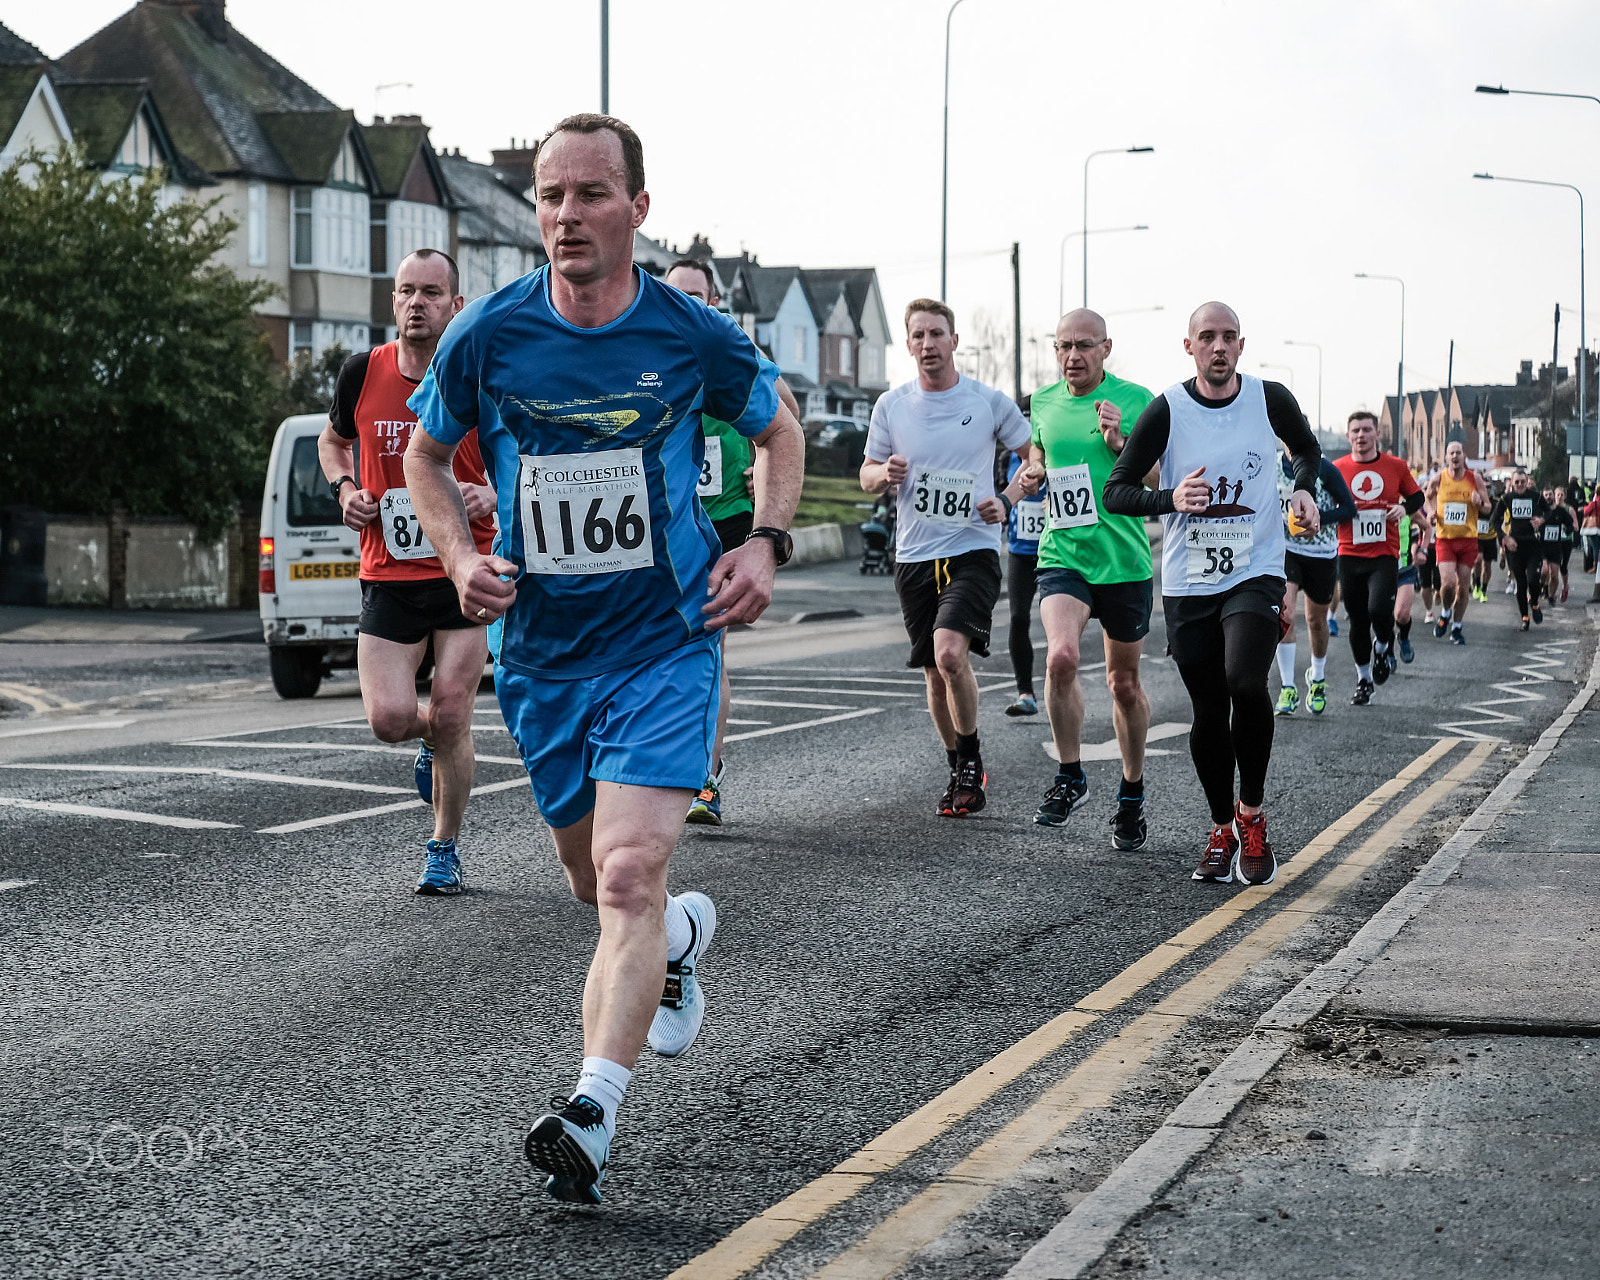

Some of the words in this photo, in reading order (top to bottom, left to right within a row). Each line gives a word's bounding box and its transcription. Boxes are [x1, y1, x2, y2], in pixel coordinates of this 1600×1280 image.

[544, 465, 640, 483] COLCHESTER
[547, 487, 575, 495] HALF
[578, 481, 640, 493] MARATHON
[915, 487, 971, 518] 3184
[393, 515, 423, 548] 87
[531, 494, 646, 556] 1166
[1360, 521, 1382, 537] 100
[1201, 531, 1250, 539] COLCHESTER
[588, 560, 622, 568] CHAPMAN
[1203, 546, 1234, 575] 58
[294, 565, 331, 579] LG55
